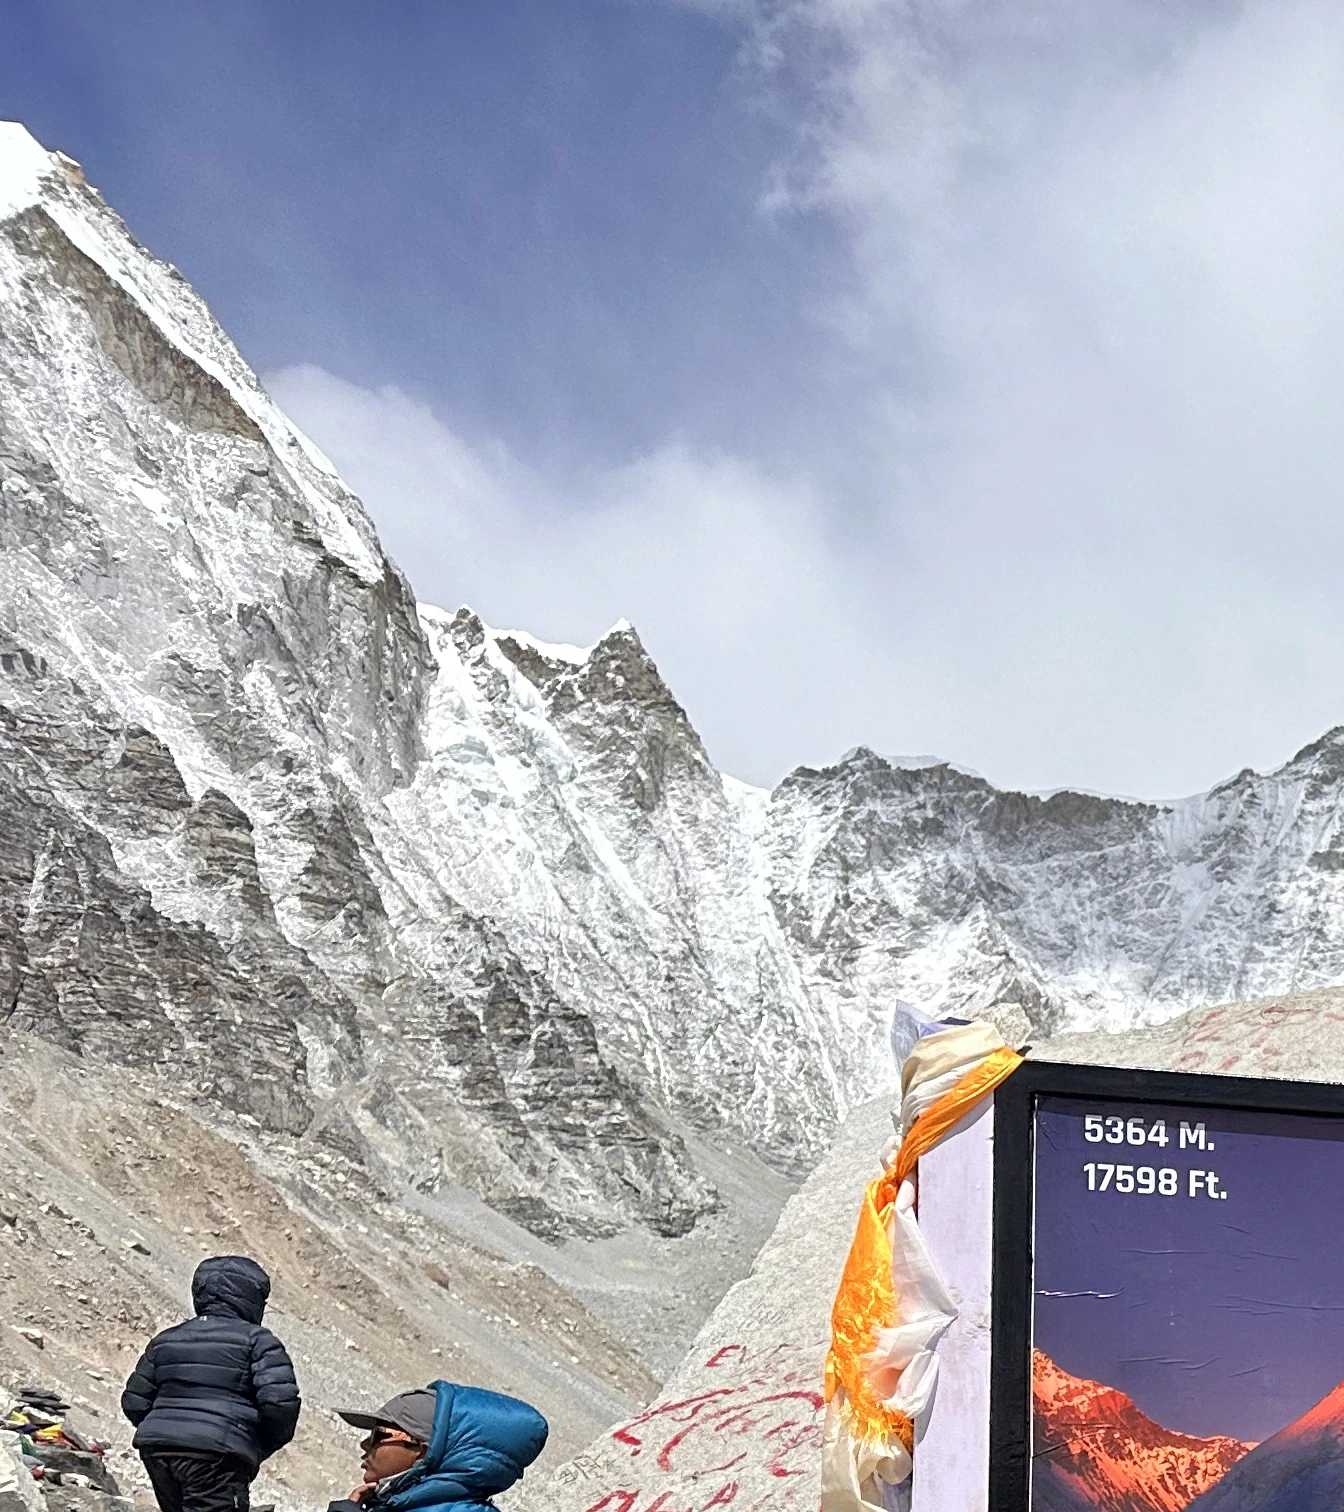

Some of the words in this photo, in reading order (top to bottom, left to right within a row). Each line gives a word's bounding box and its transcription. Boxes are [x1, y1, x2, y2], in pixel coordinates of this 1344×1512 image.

[1084, 1114, 1170, 1148] 5364
[1179, 1121, 1215, 1151] M.
[1083, 1162, 1178, 1196] 17598
[1188, 1169, 1228, 1200] Ft.
